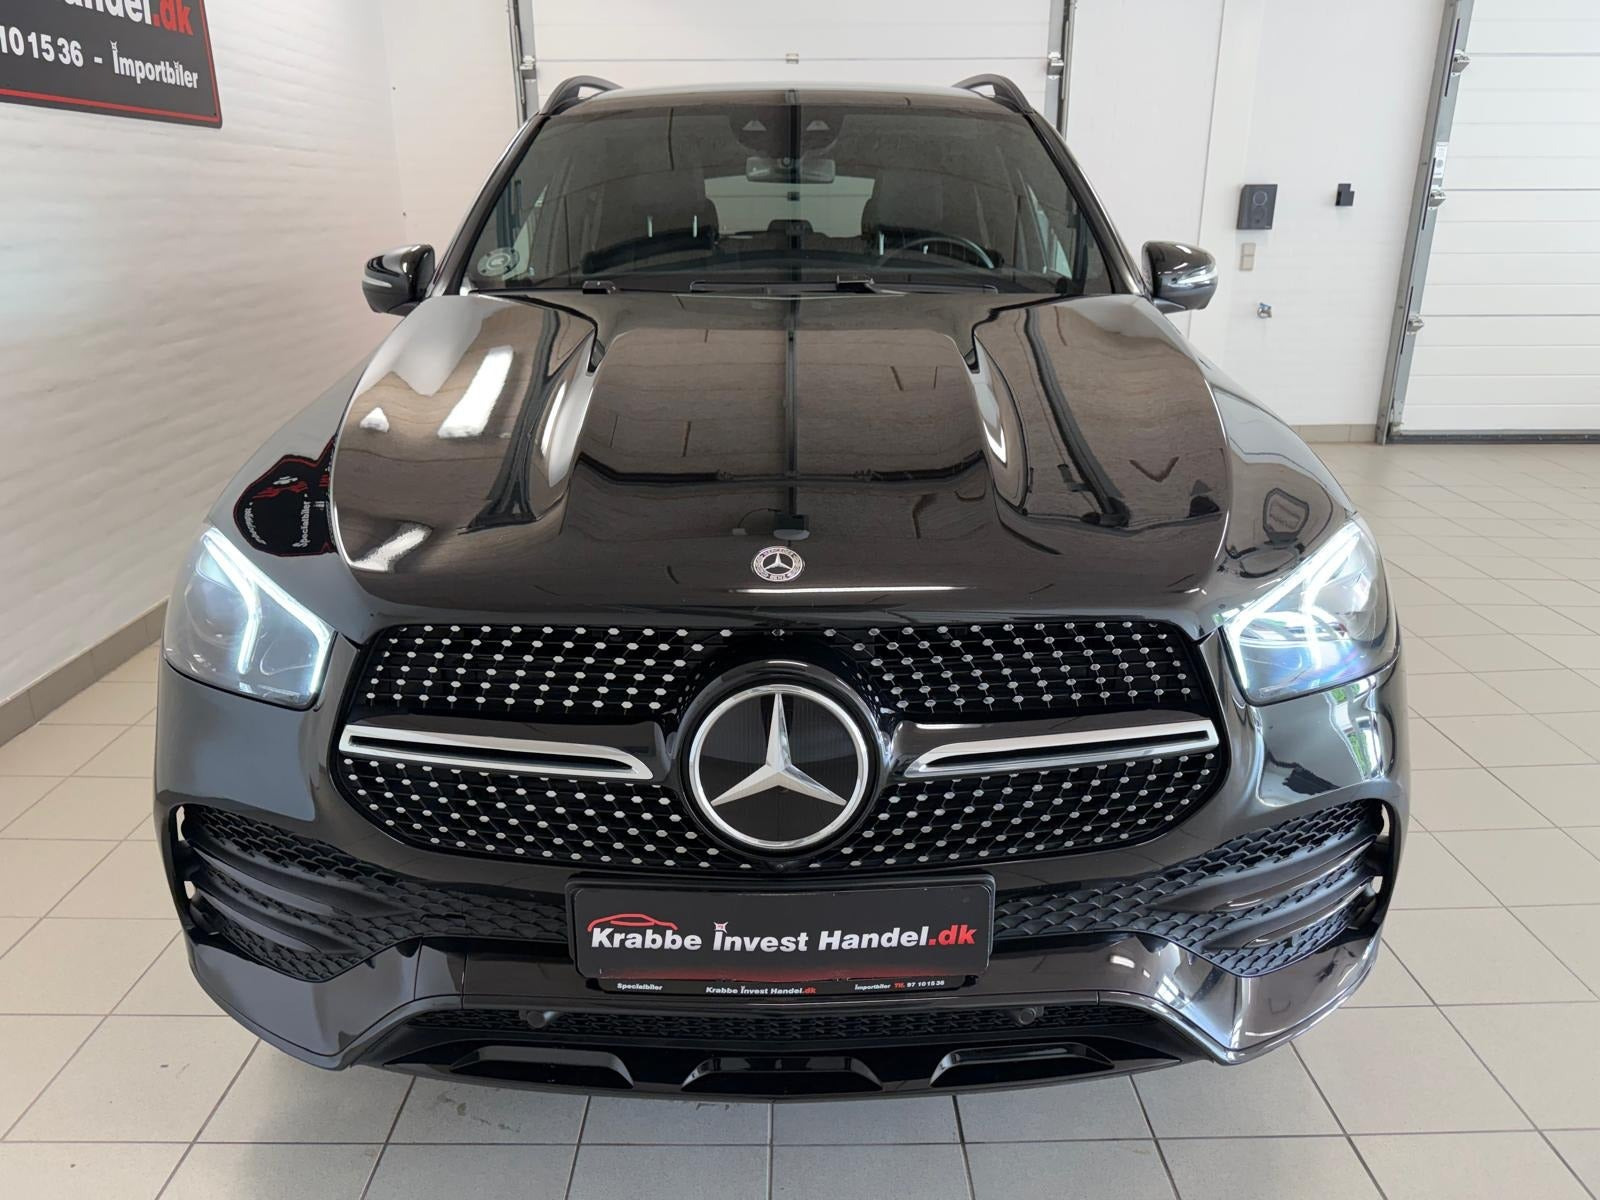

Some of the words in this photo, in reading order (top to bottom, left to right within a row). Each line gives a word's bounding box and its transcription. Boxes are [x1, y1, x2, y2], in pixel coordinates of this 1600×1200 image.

[110, 40, 199, 89] Importbiler
[591, 927, 702, 951] Krabbe
[712, 922, 808, 952] Invest
[817, 924, 977, 951] Handel.dk
[705, 986, 739, 994] Krabbe
[740, 985, 768, 995] Invest
